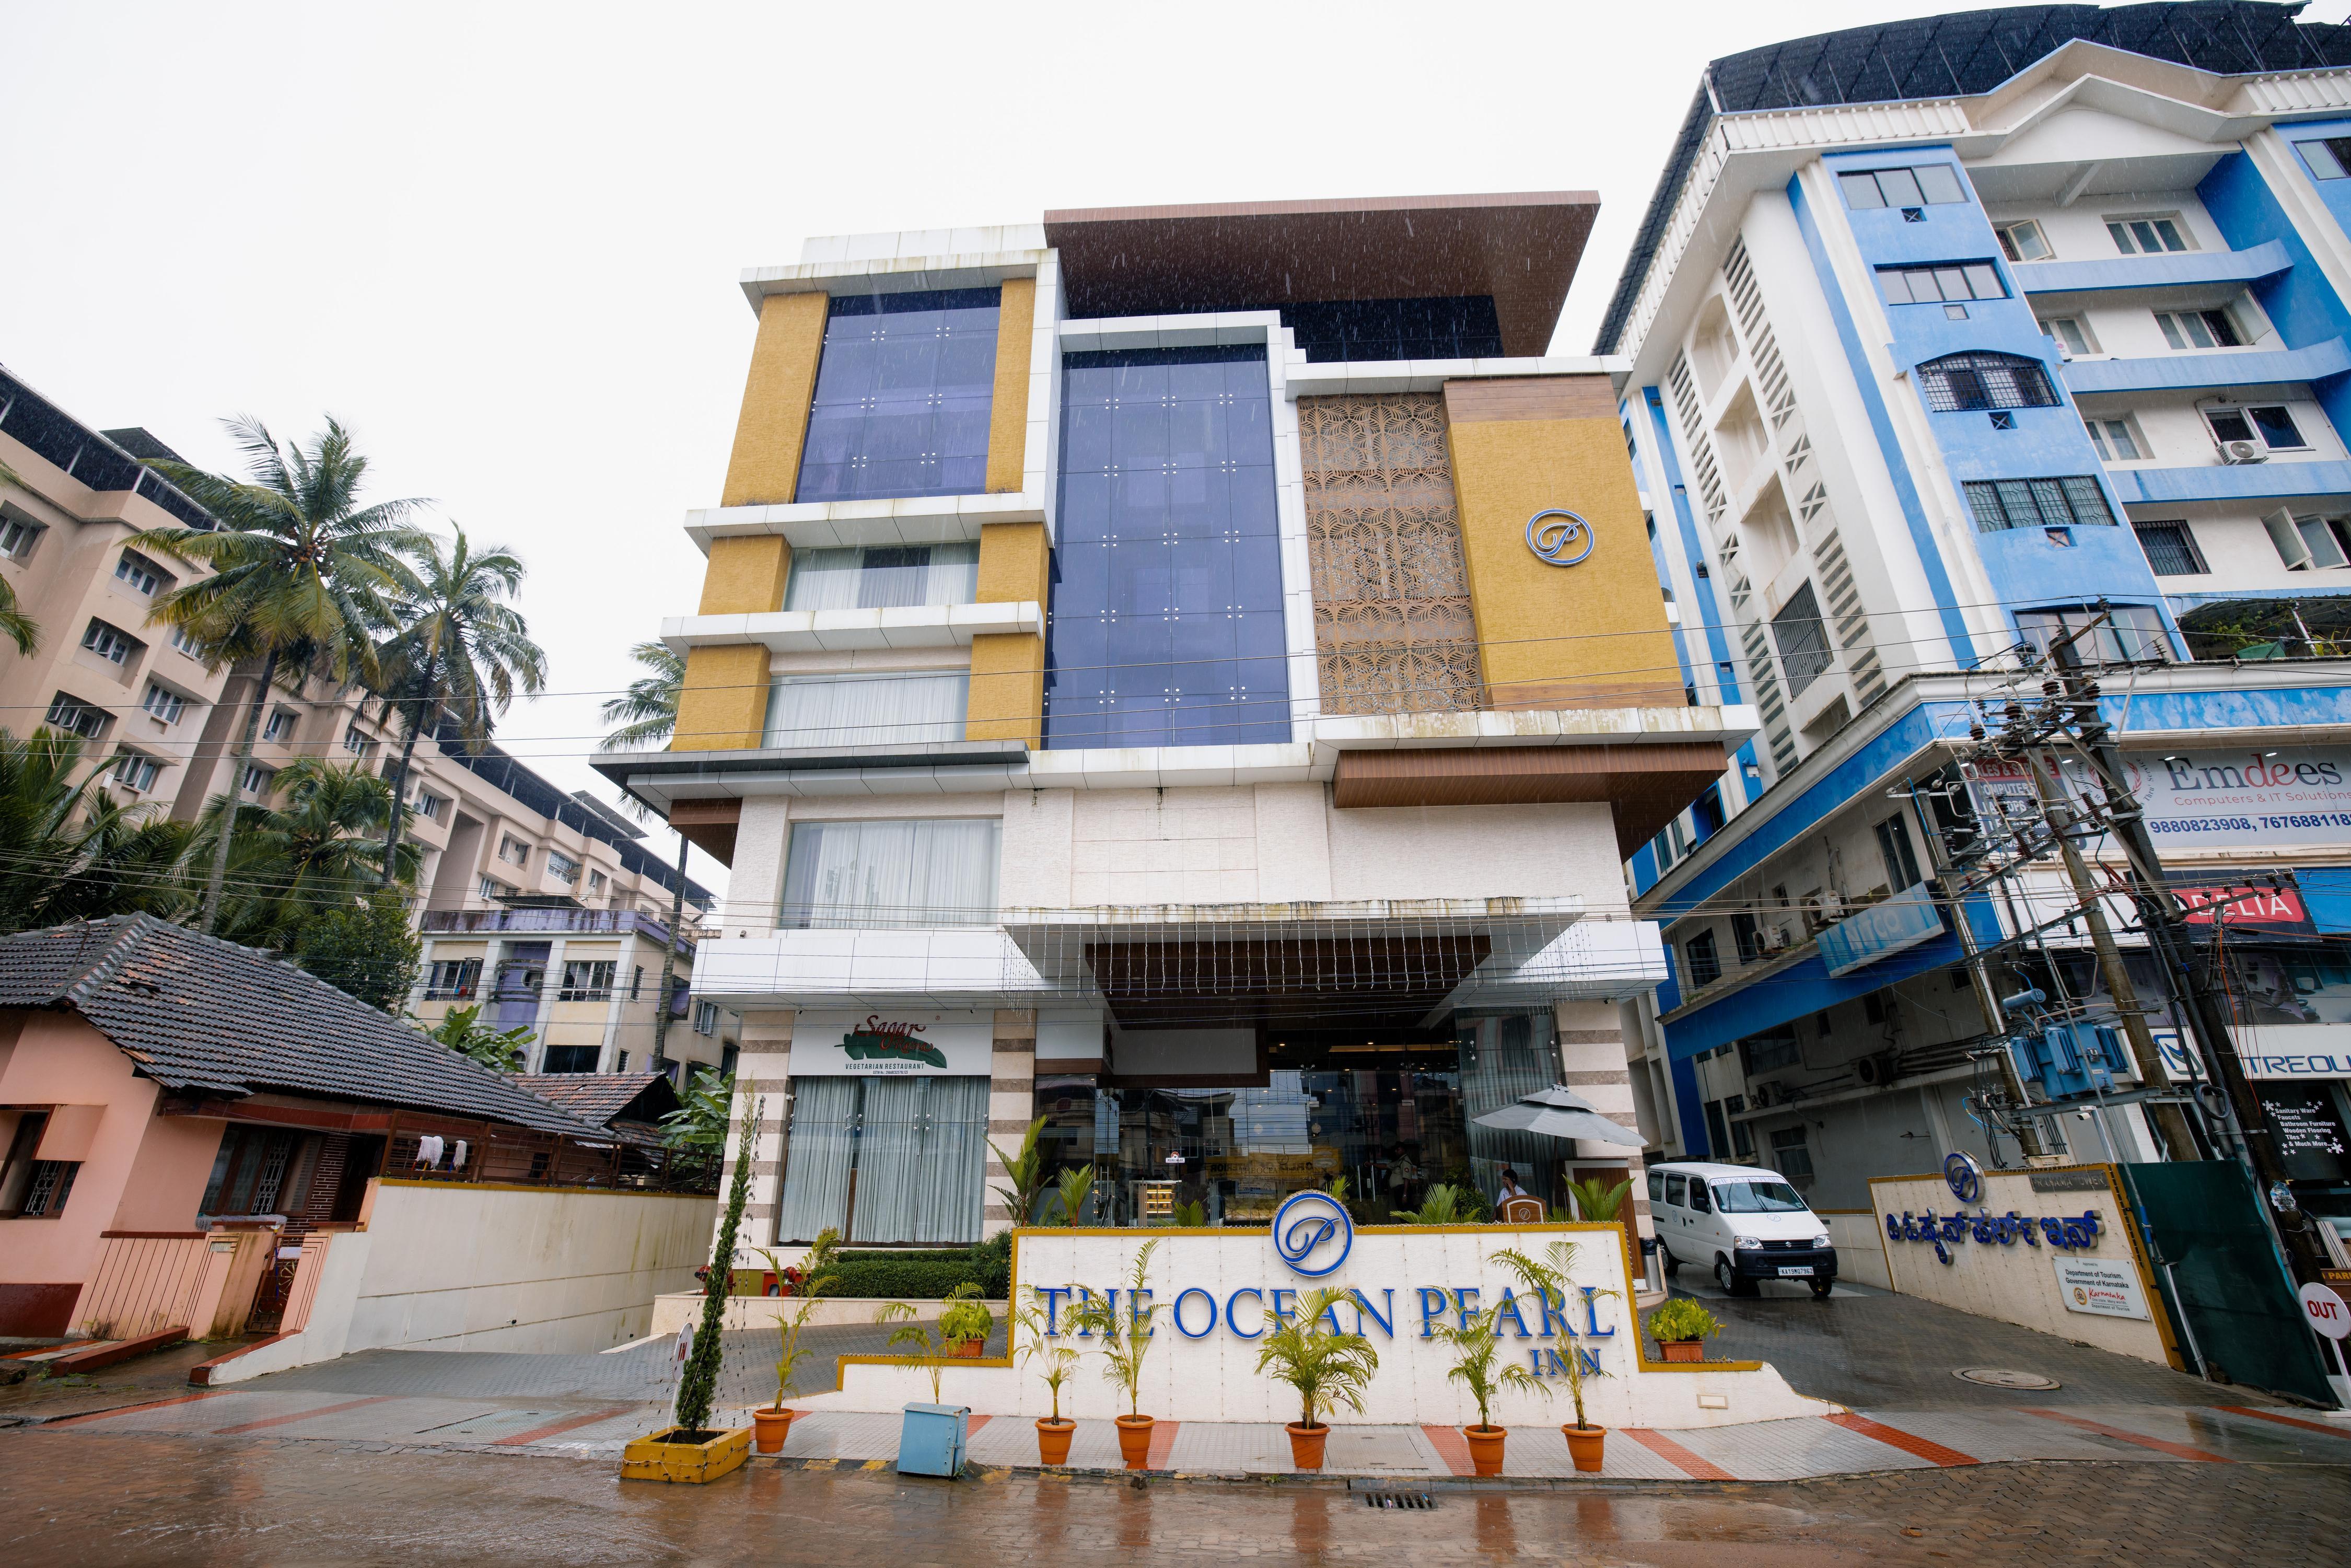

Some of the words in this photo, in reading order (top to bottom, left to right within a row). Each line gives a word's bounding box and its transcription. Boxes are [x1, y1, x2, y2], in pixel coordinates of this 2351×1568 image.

[2002, 763, 2011, 776] &
[2158, 753, 2343, 791] Emdees
[2174, 794, 2253, 807] Computers
[2257, 793, 2266, 802] &
[2269, 793, 2282, 802] IT
[2287, 791, 2351, 802] Solutions
[2150, 817, 2257, 833] 9880823908,
[2259, 813, 2351, 829] 767688118
[2191, 893, 2292, 917] DELTA
[854, 1015, 926, 1050] Sagar
[2065, 1277, 2095, 1286] Government
[2102, 1280, 2129, 1288] Karnataka
[2089, 1287, 2126, 1300] Karnataka
[1035, 1286, 1155, 1338] THE
[1173, 1287, 1395, 1340] OCEAN
[1415, 1286, 1615, 1338] PEARL
[2307, 1300, 2338, 1320] OUT
[677, 1342, 688, 1362] IN
[1528, 1347, 1601, 1377] INN
